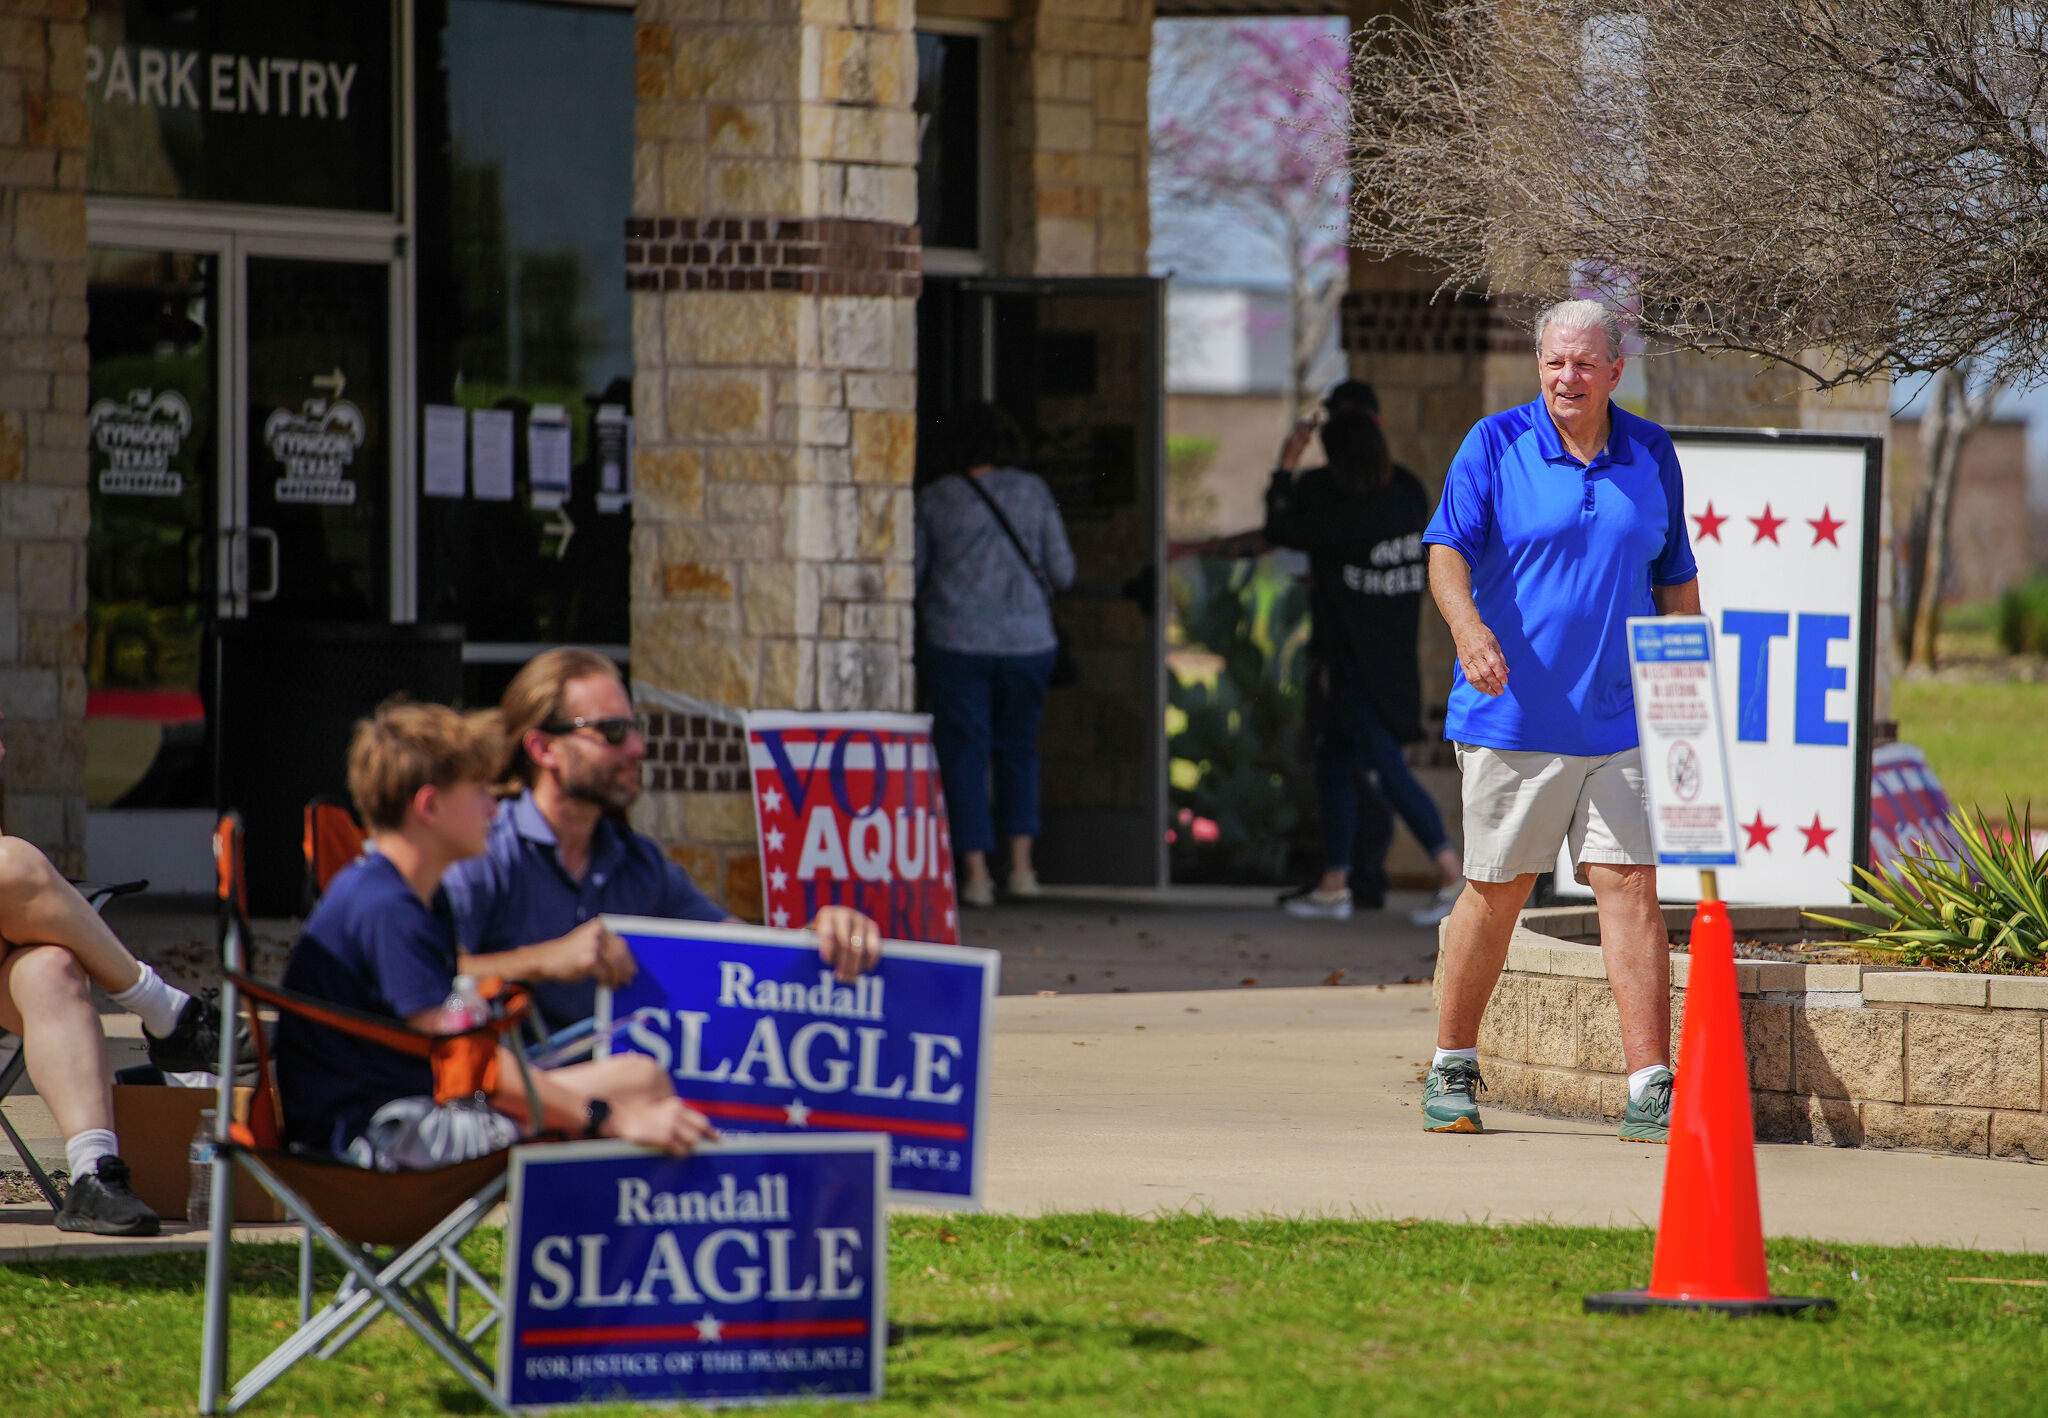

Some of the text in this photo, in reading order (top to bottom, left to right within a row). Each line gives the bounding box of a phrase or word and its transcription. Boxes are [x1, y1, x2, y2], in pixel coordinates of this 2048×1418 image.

[87, 44, 358, 121] PARK ENTRY
[1721, 610, 1850, 747] TE
[796, 805, 940, 885] AQUI
[716, 960, 885, 1022] Randall
[627, 1005, 964, 1105] SLAGLE
[615, 1173, 792, 1226] Randall
[528, 1227, 865, 1310] SLAGLE
[568, 1352, 664, 1383] JUSTICE
